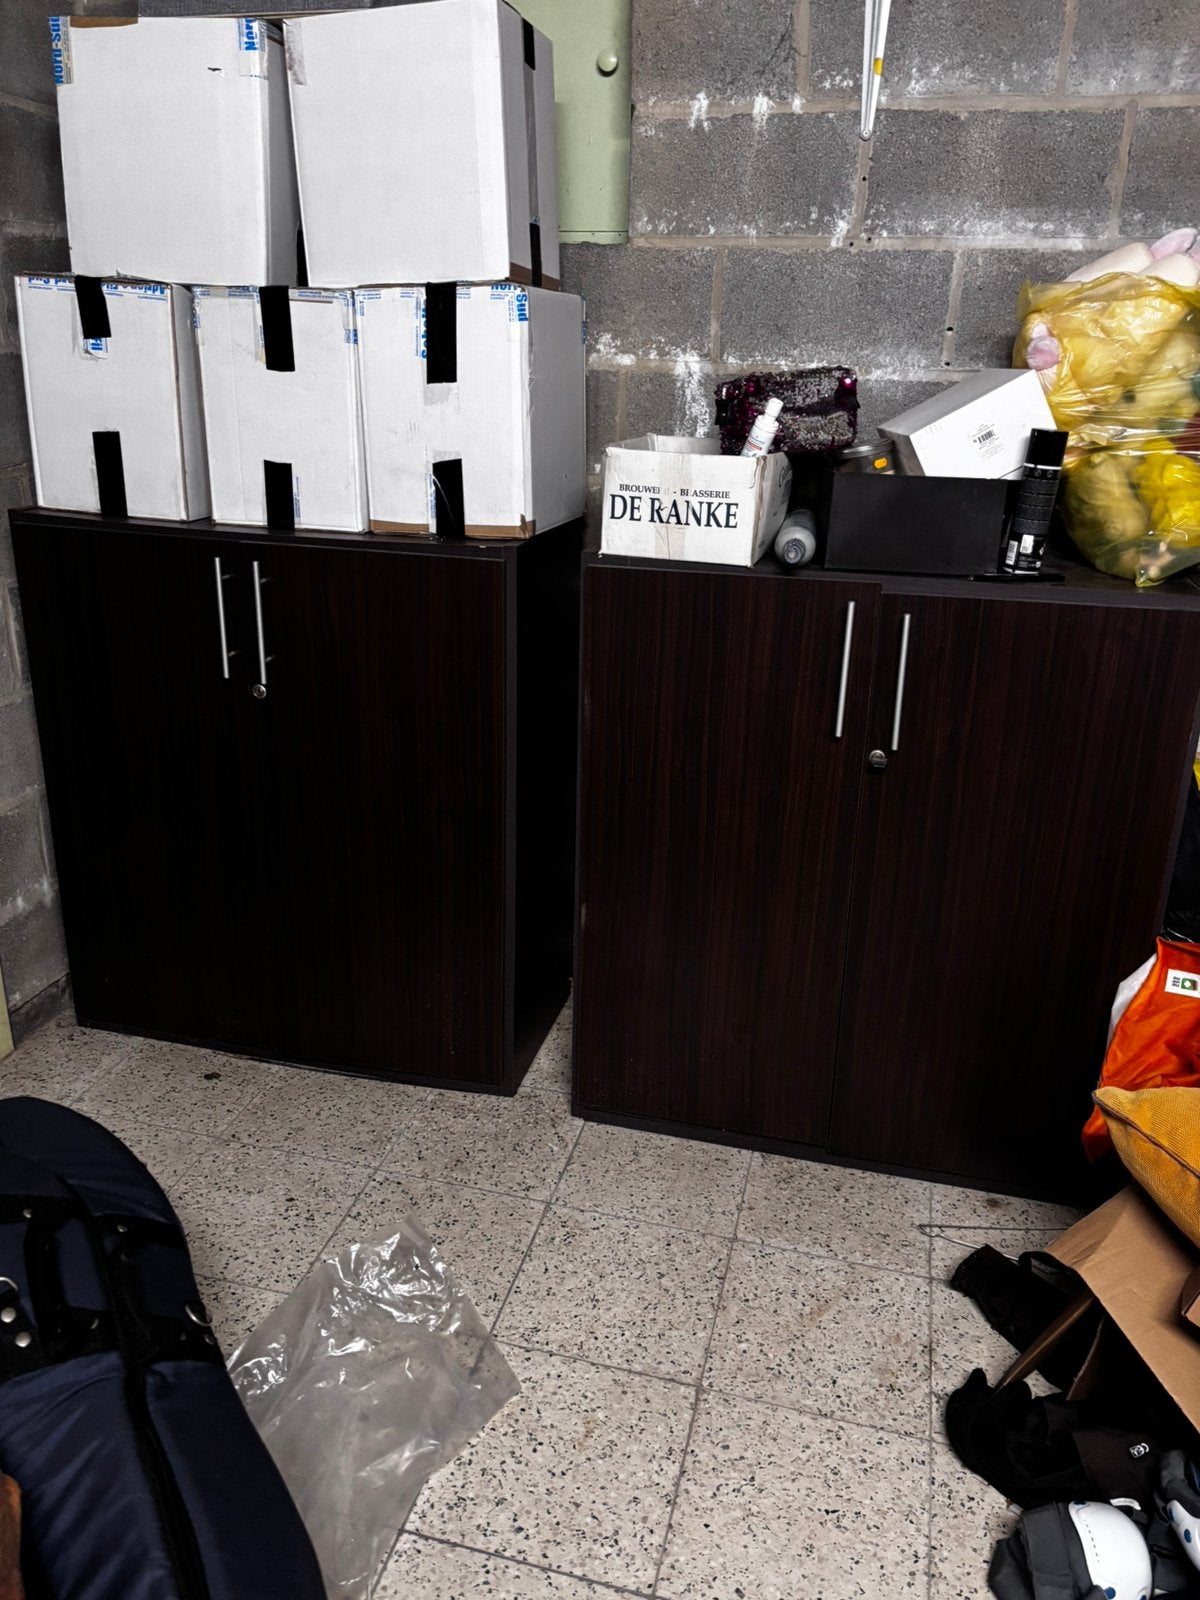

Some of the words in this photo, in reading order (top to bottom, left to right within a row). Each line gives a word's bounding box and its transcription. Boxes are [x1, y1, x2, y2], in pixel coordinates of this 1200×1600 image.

[619, 483, 669, 496] BROUWE
[609, 493, 643, 522] DE
[648, 497, 739, 528] RANKE
